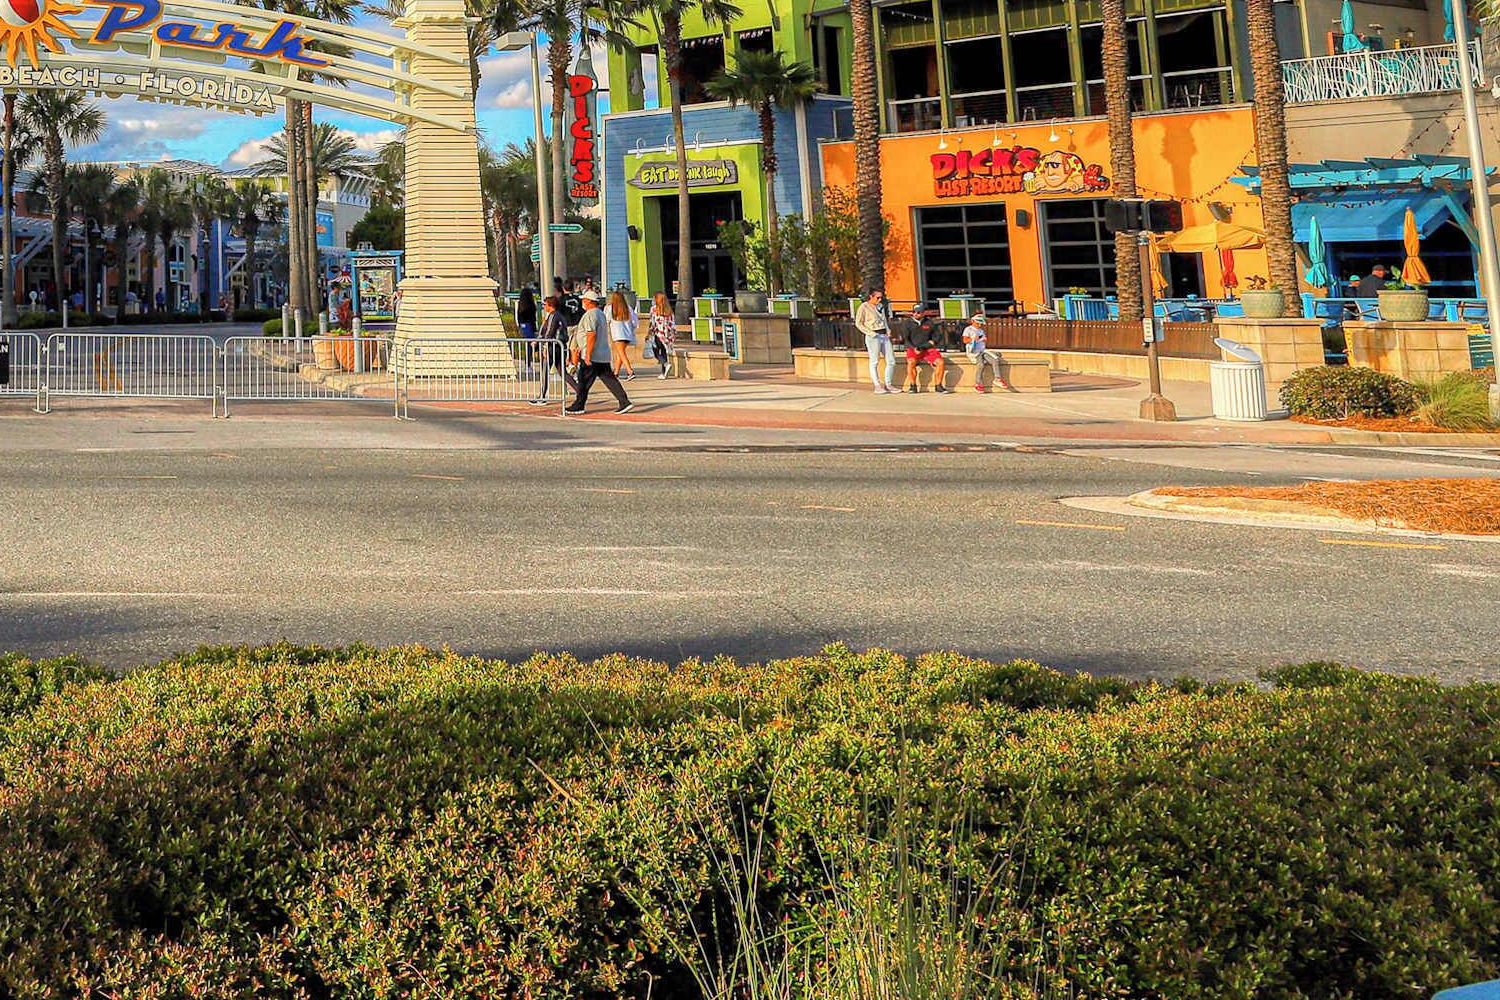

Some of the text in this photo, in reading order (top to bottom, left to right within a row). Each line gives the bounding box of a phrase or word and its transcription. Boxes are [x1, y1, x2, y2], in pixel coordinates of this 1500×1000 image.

[139, 72, 277, 109] FLORIDA
[568, 75, 594, 183] DICK'S
[641, 165, 730, 183] EAT DRNK laugh
[931, 146, 1041, 179] DICK'S
[934, 176, 1023, 197] LAST RESORT
